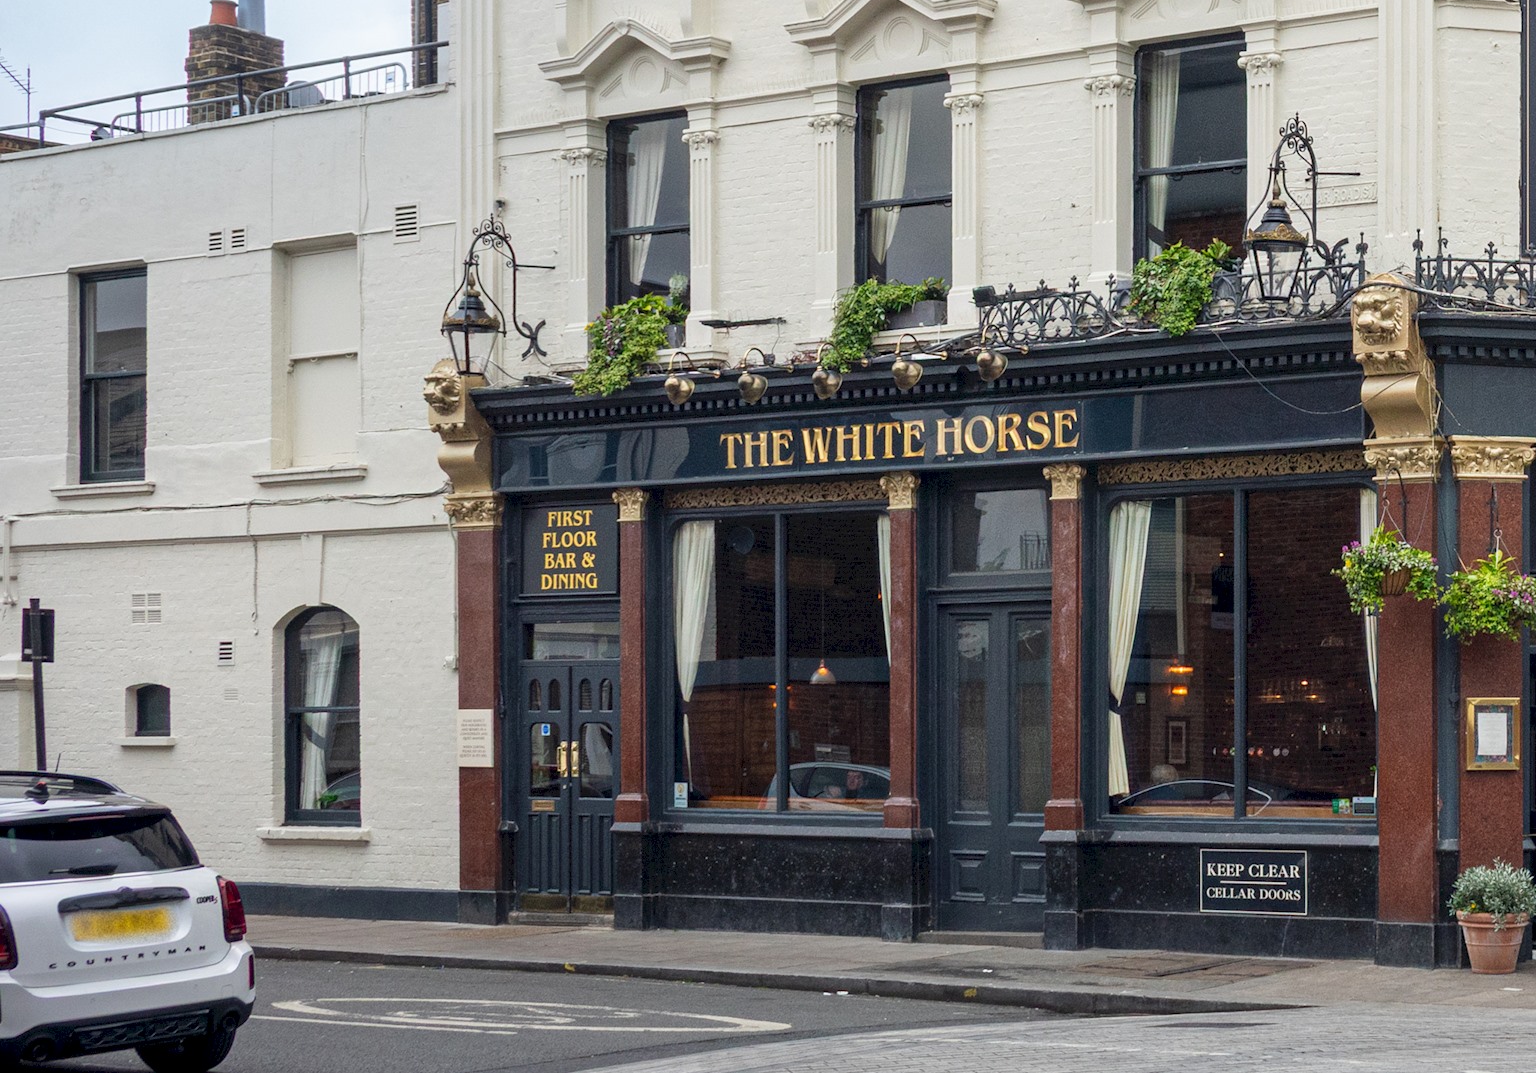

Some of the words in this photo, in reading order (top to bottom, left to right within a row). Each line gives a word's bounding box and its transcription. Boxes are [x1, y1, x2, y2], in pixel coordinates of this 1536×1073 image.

[719, 428, 795, 469] THE
[801, 419, 926, 464] WHITE
[935, 408, 1081, 457] HORSE
[547, 510, 593, 528] FIRST
[542, 530, 598, 549] FLOOR
[544, 552, 577, 570] BAR
[581, 551, 596, 568] &
[541, 572, 598, 590] DINING
[1206, 862, 1245, 877] KEEP
[1248, 863, 1301, 879] CLEAR
[1206, 886, 1256, 900] CELLAR
[1259, 888, 1302, 901] DOORS
[48, 944, 207, 970] COUNTRYMAN
